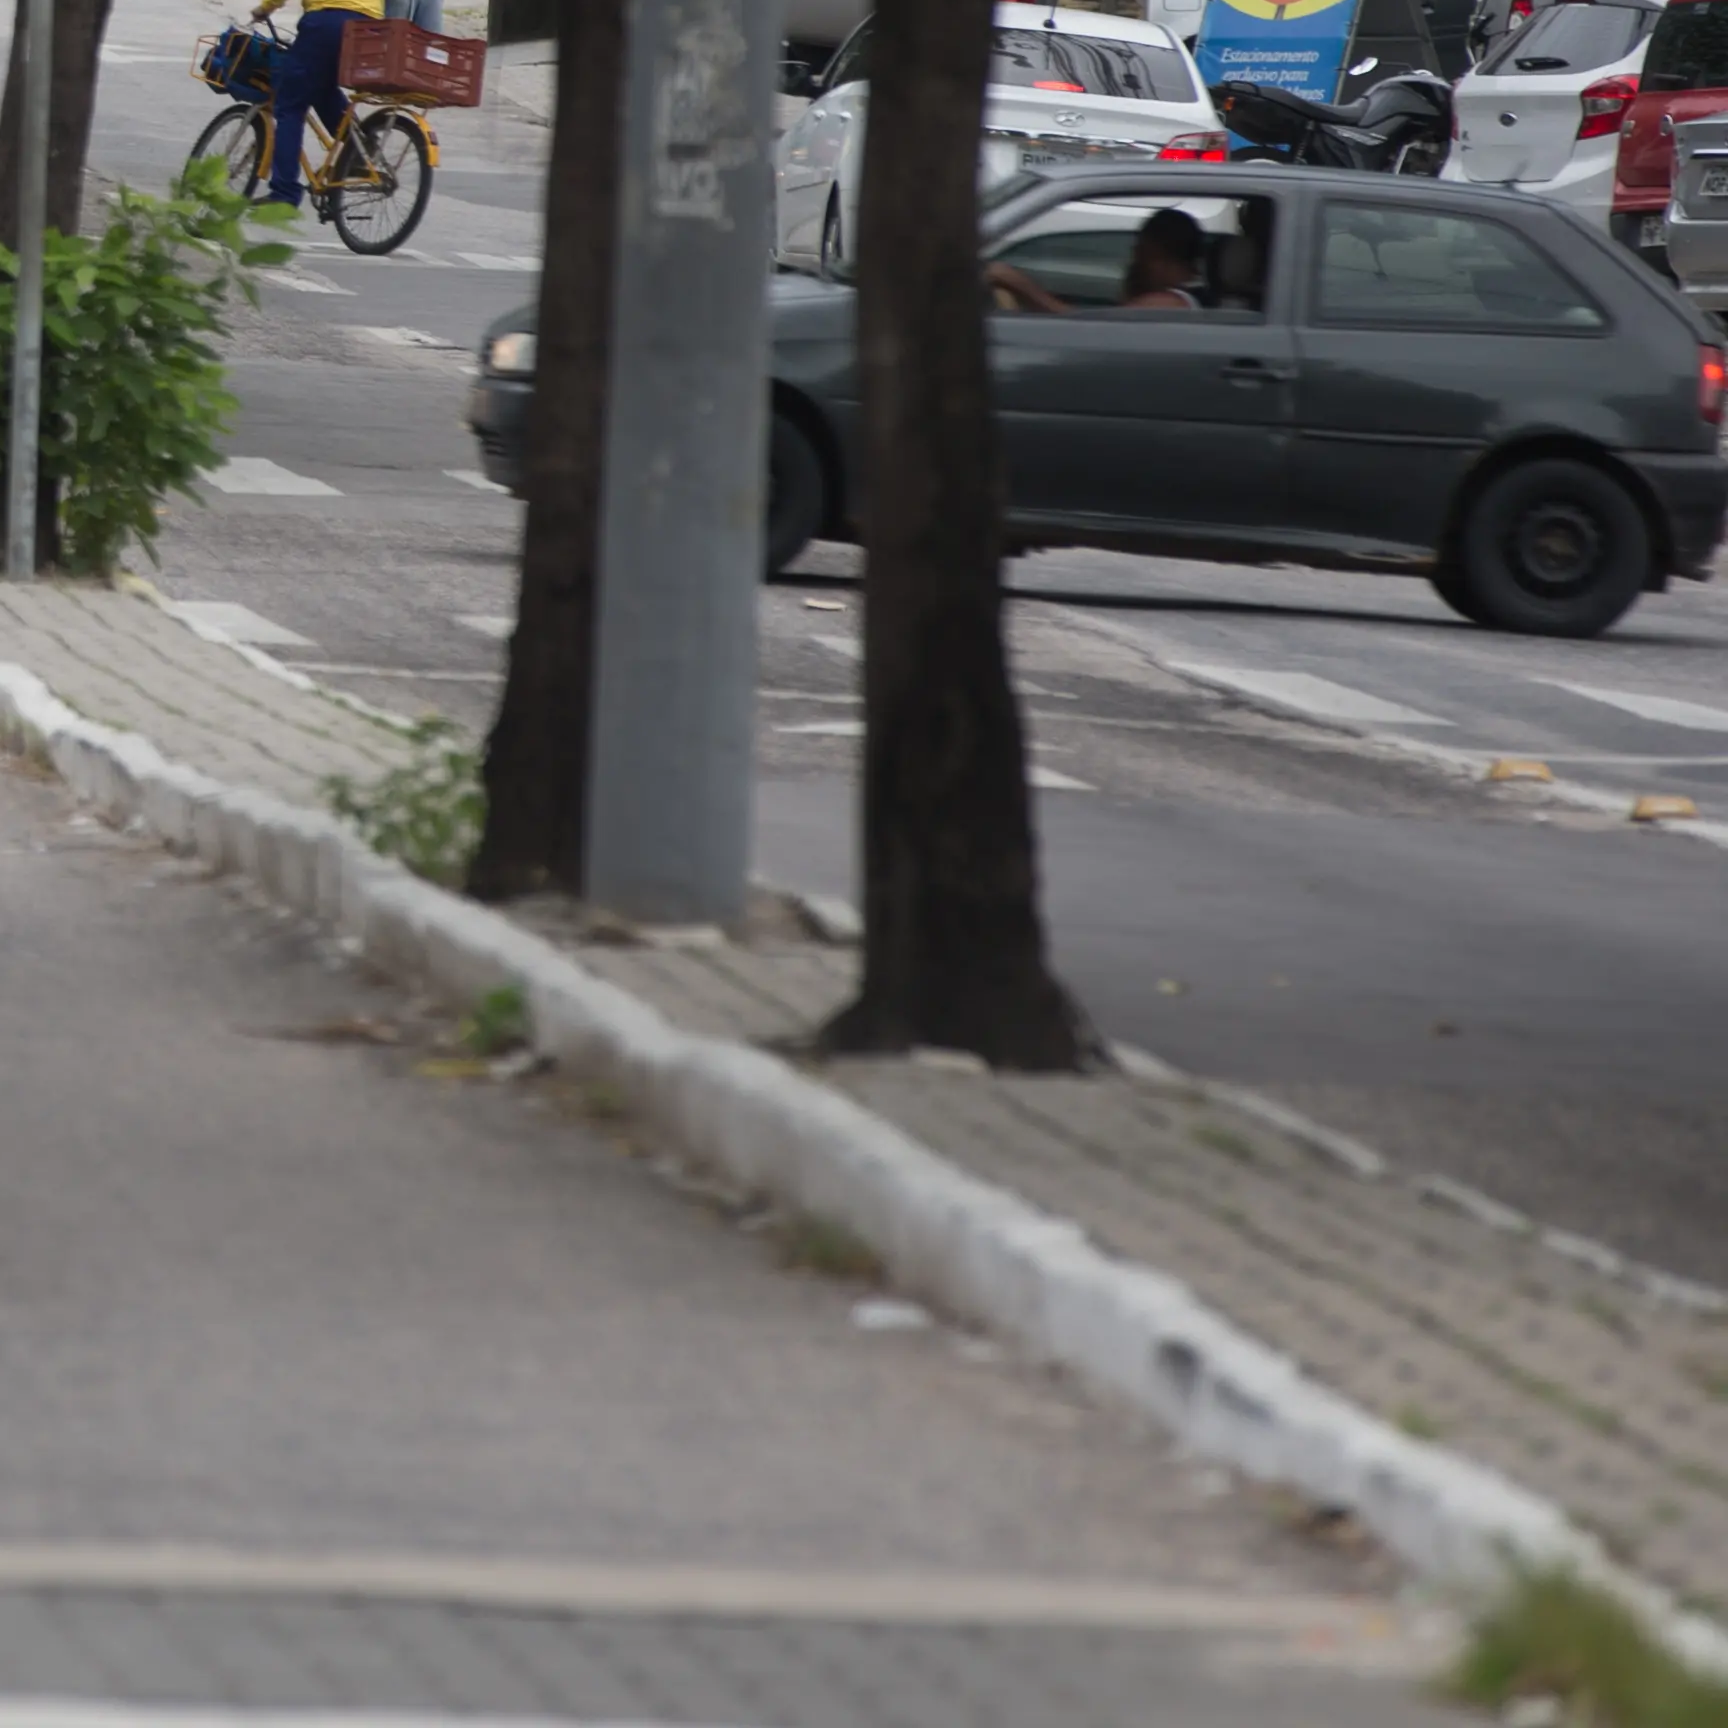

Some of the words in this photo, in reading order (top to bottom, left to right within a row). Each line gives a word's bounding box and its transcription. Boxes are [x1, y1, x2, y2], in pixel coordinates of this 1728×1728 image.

[1221, 48, 1319, 64] Estacionamento
[1222, 66, 1278, 82] exclusivo
[1278, 70, 1309, 86] para
